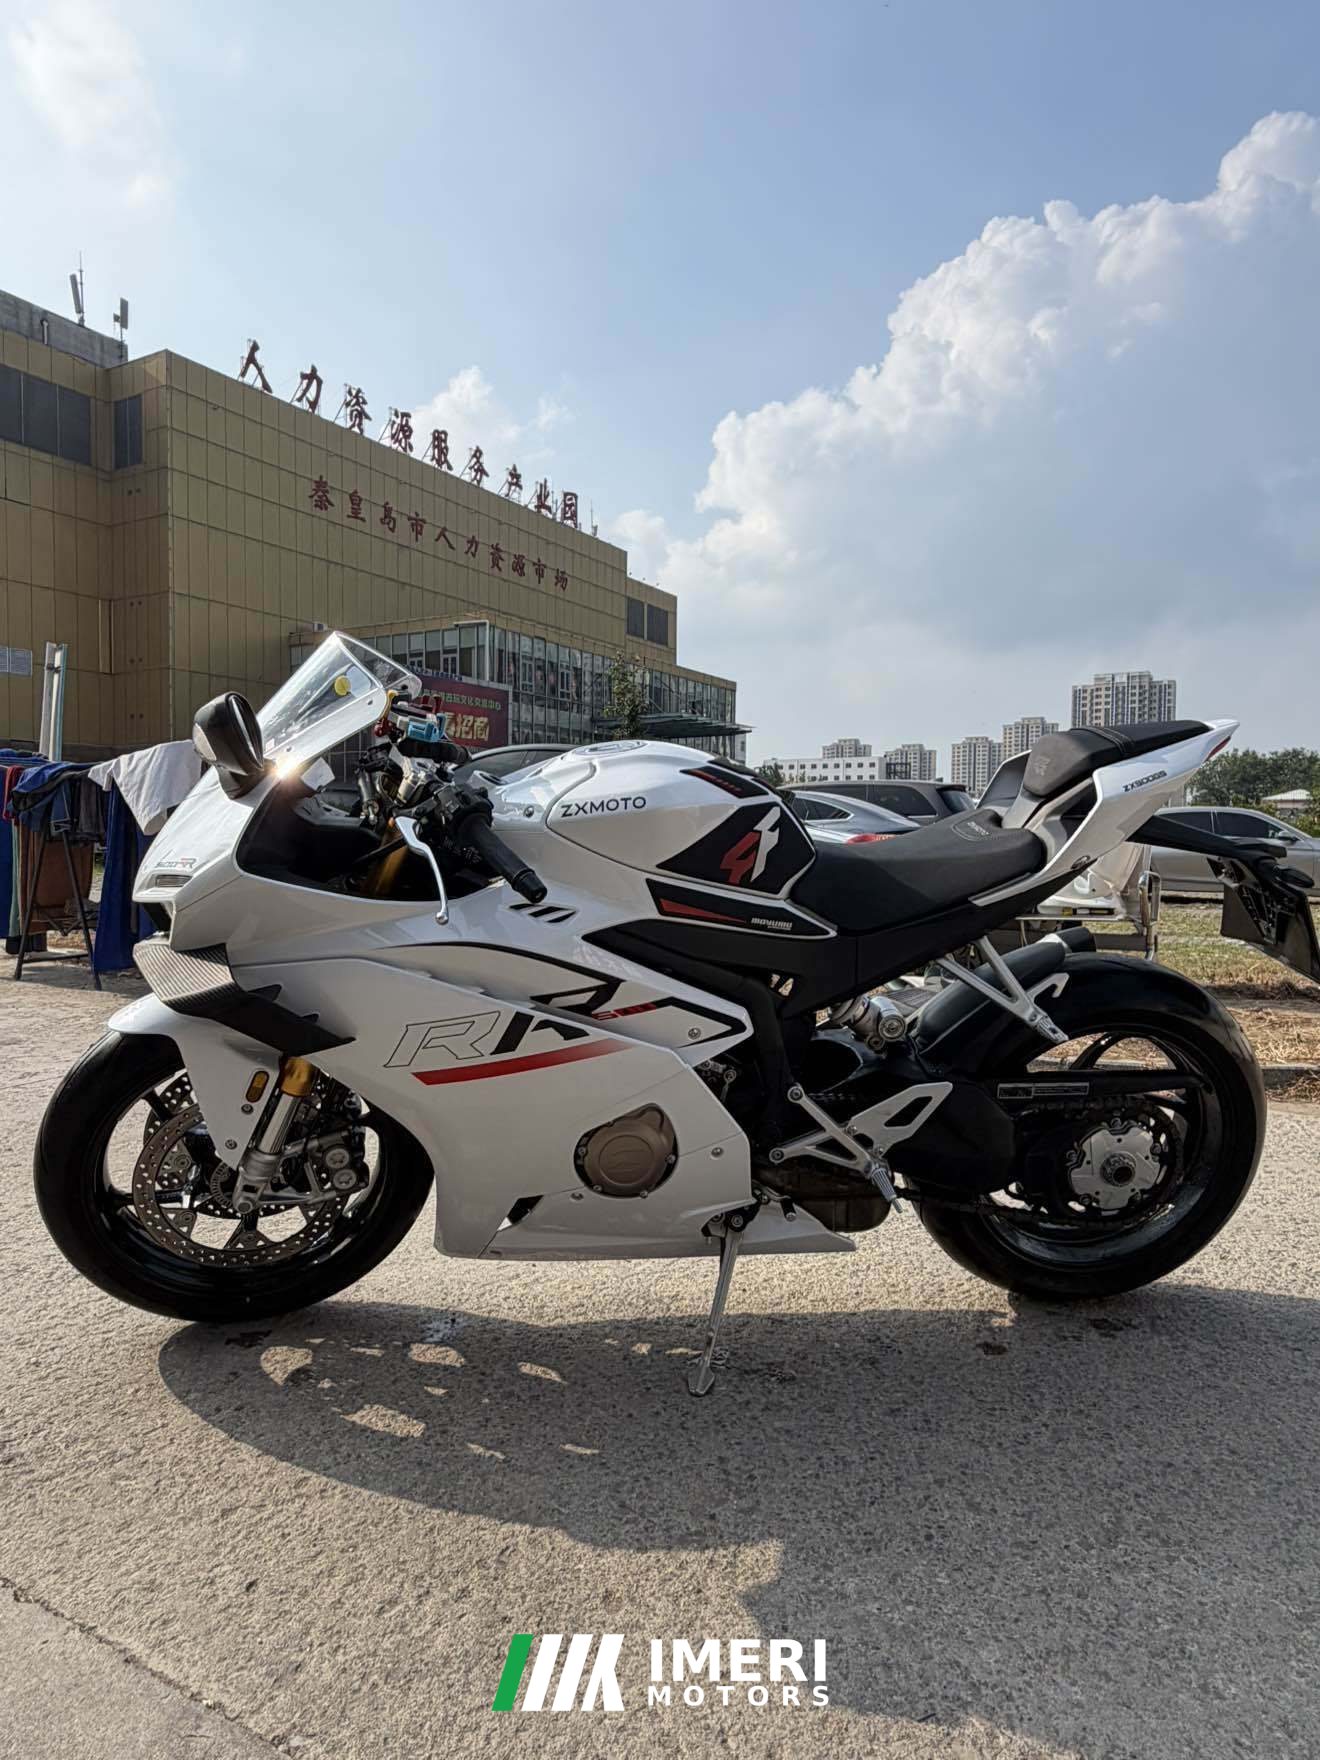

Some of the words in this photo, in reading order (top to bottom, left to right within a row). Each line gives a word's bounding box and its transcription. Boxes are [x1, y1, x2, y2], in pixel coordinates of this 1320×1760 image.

[240, 339, 578, 528] 人力资源服务产业园
[308, 475, 568, 591] 秦皇岛市人力资源市场
[561, 796, 647, 818] ZXMOTO
